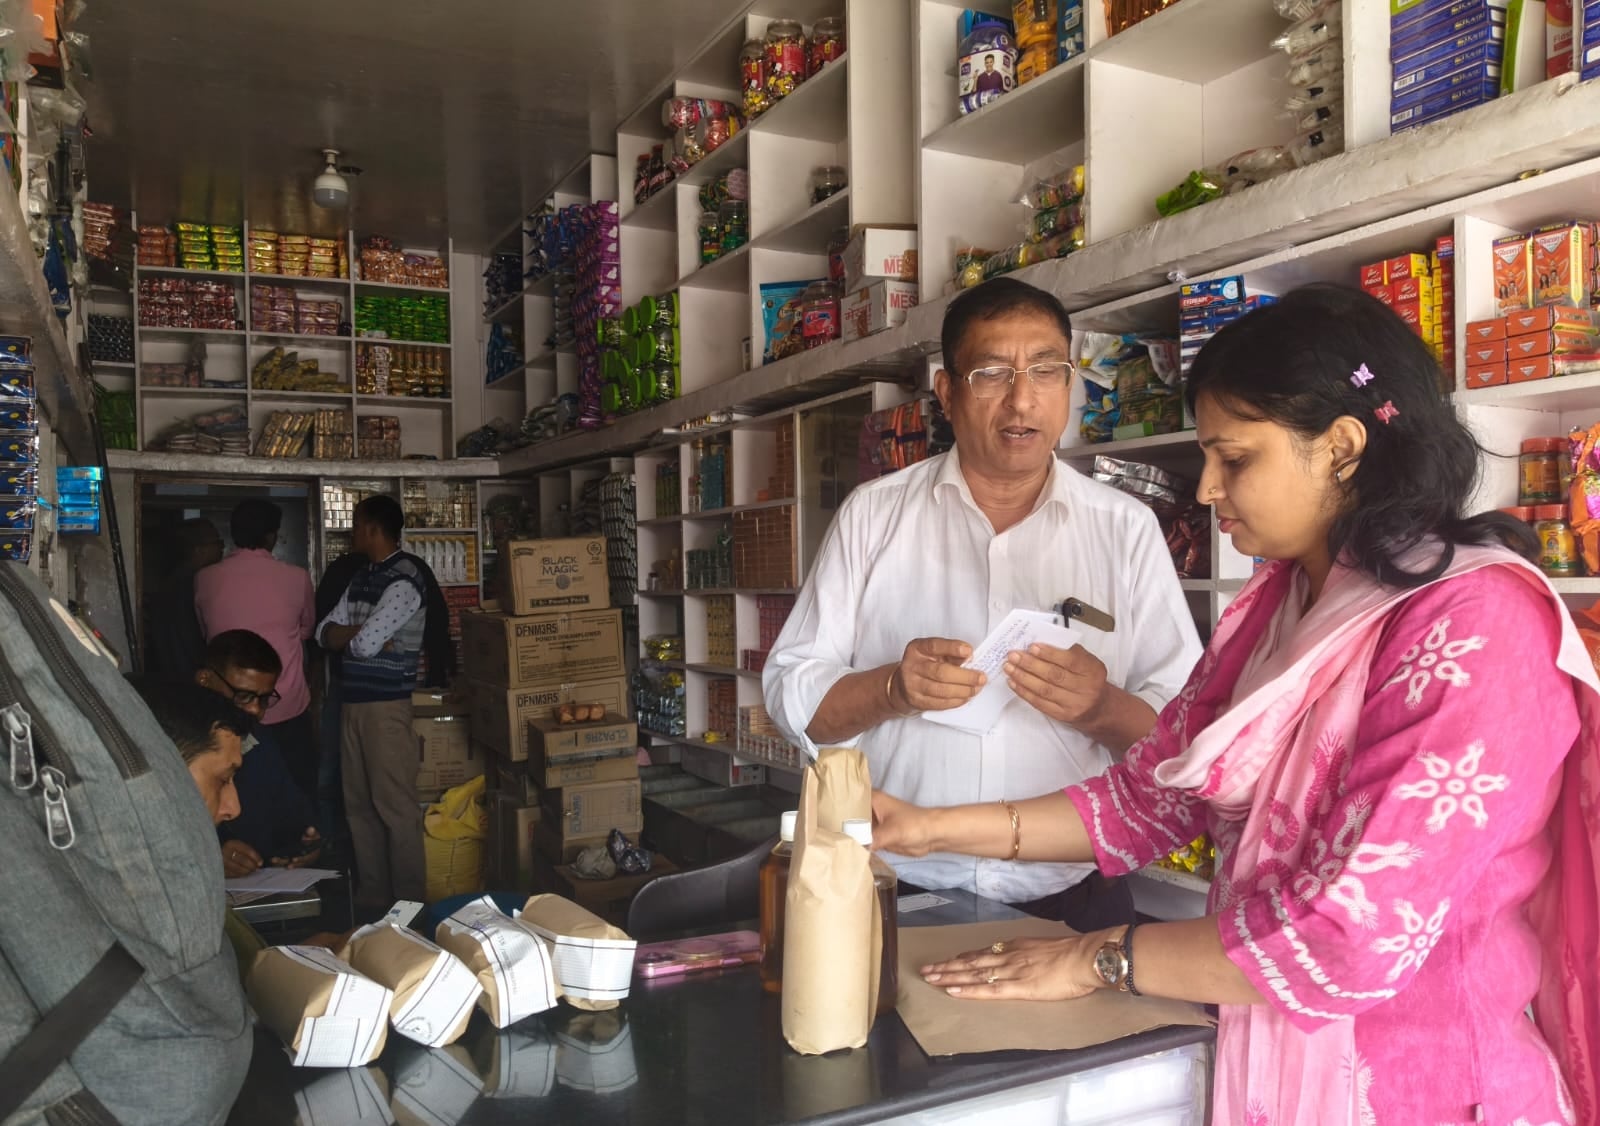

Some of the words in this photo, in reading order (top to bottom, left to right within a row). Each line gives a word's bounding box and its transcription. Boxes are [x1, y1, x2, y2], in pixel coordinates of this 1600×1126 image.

[890, 293, 919, 309] MES
[542, 556, 577, 566] BLACK
[542, 564, 579, 576] MAGIC
